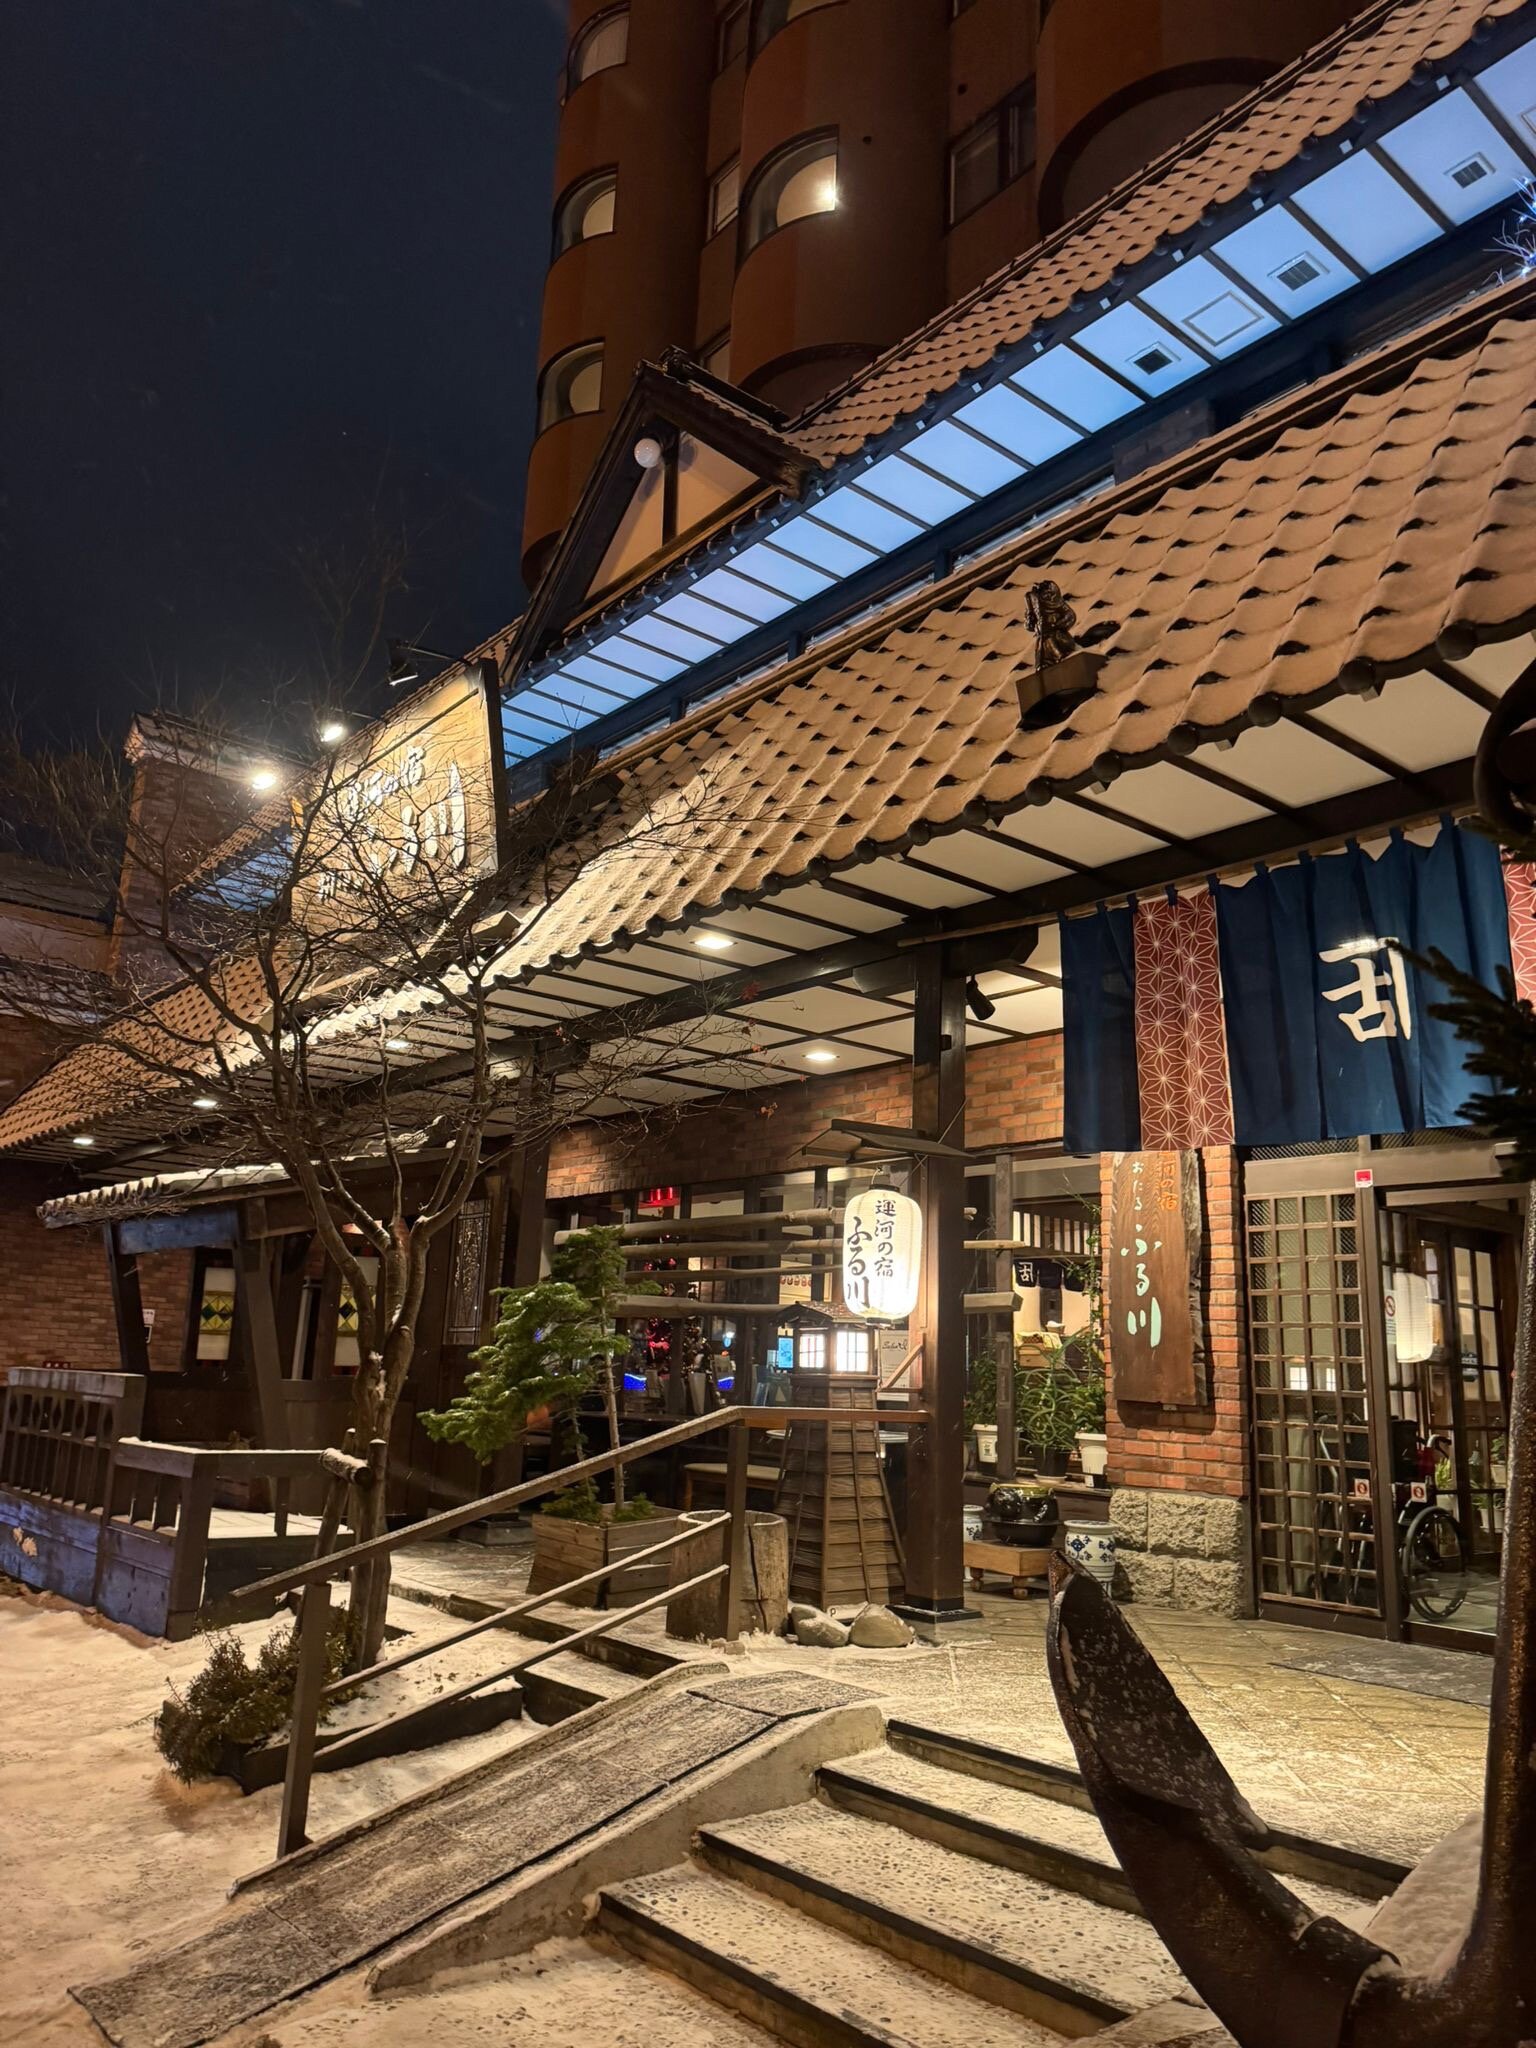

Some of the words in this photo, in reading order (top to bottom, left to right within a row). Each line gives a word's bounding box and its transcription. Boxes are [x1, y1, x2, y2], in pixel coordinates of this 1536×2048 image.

[847, 1216, 872, 1308] ふる川
[874, 1199, 896, 1277] 運河の宿
[1120, 1224, 1162, 1348] ふる川
